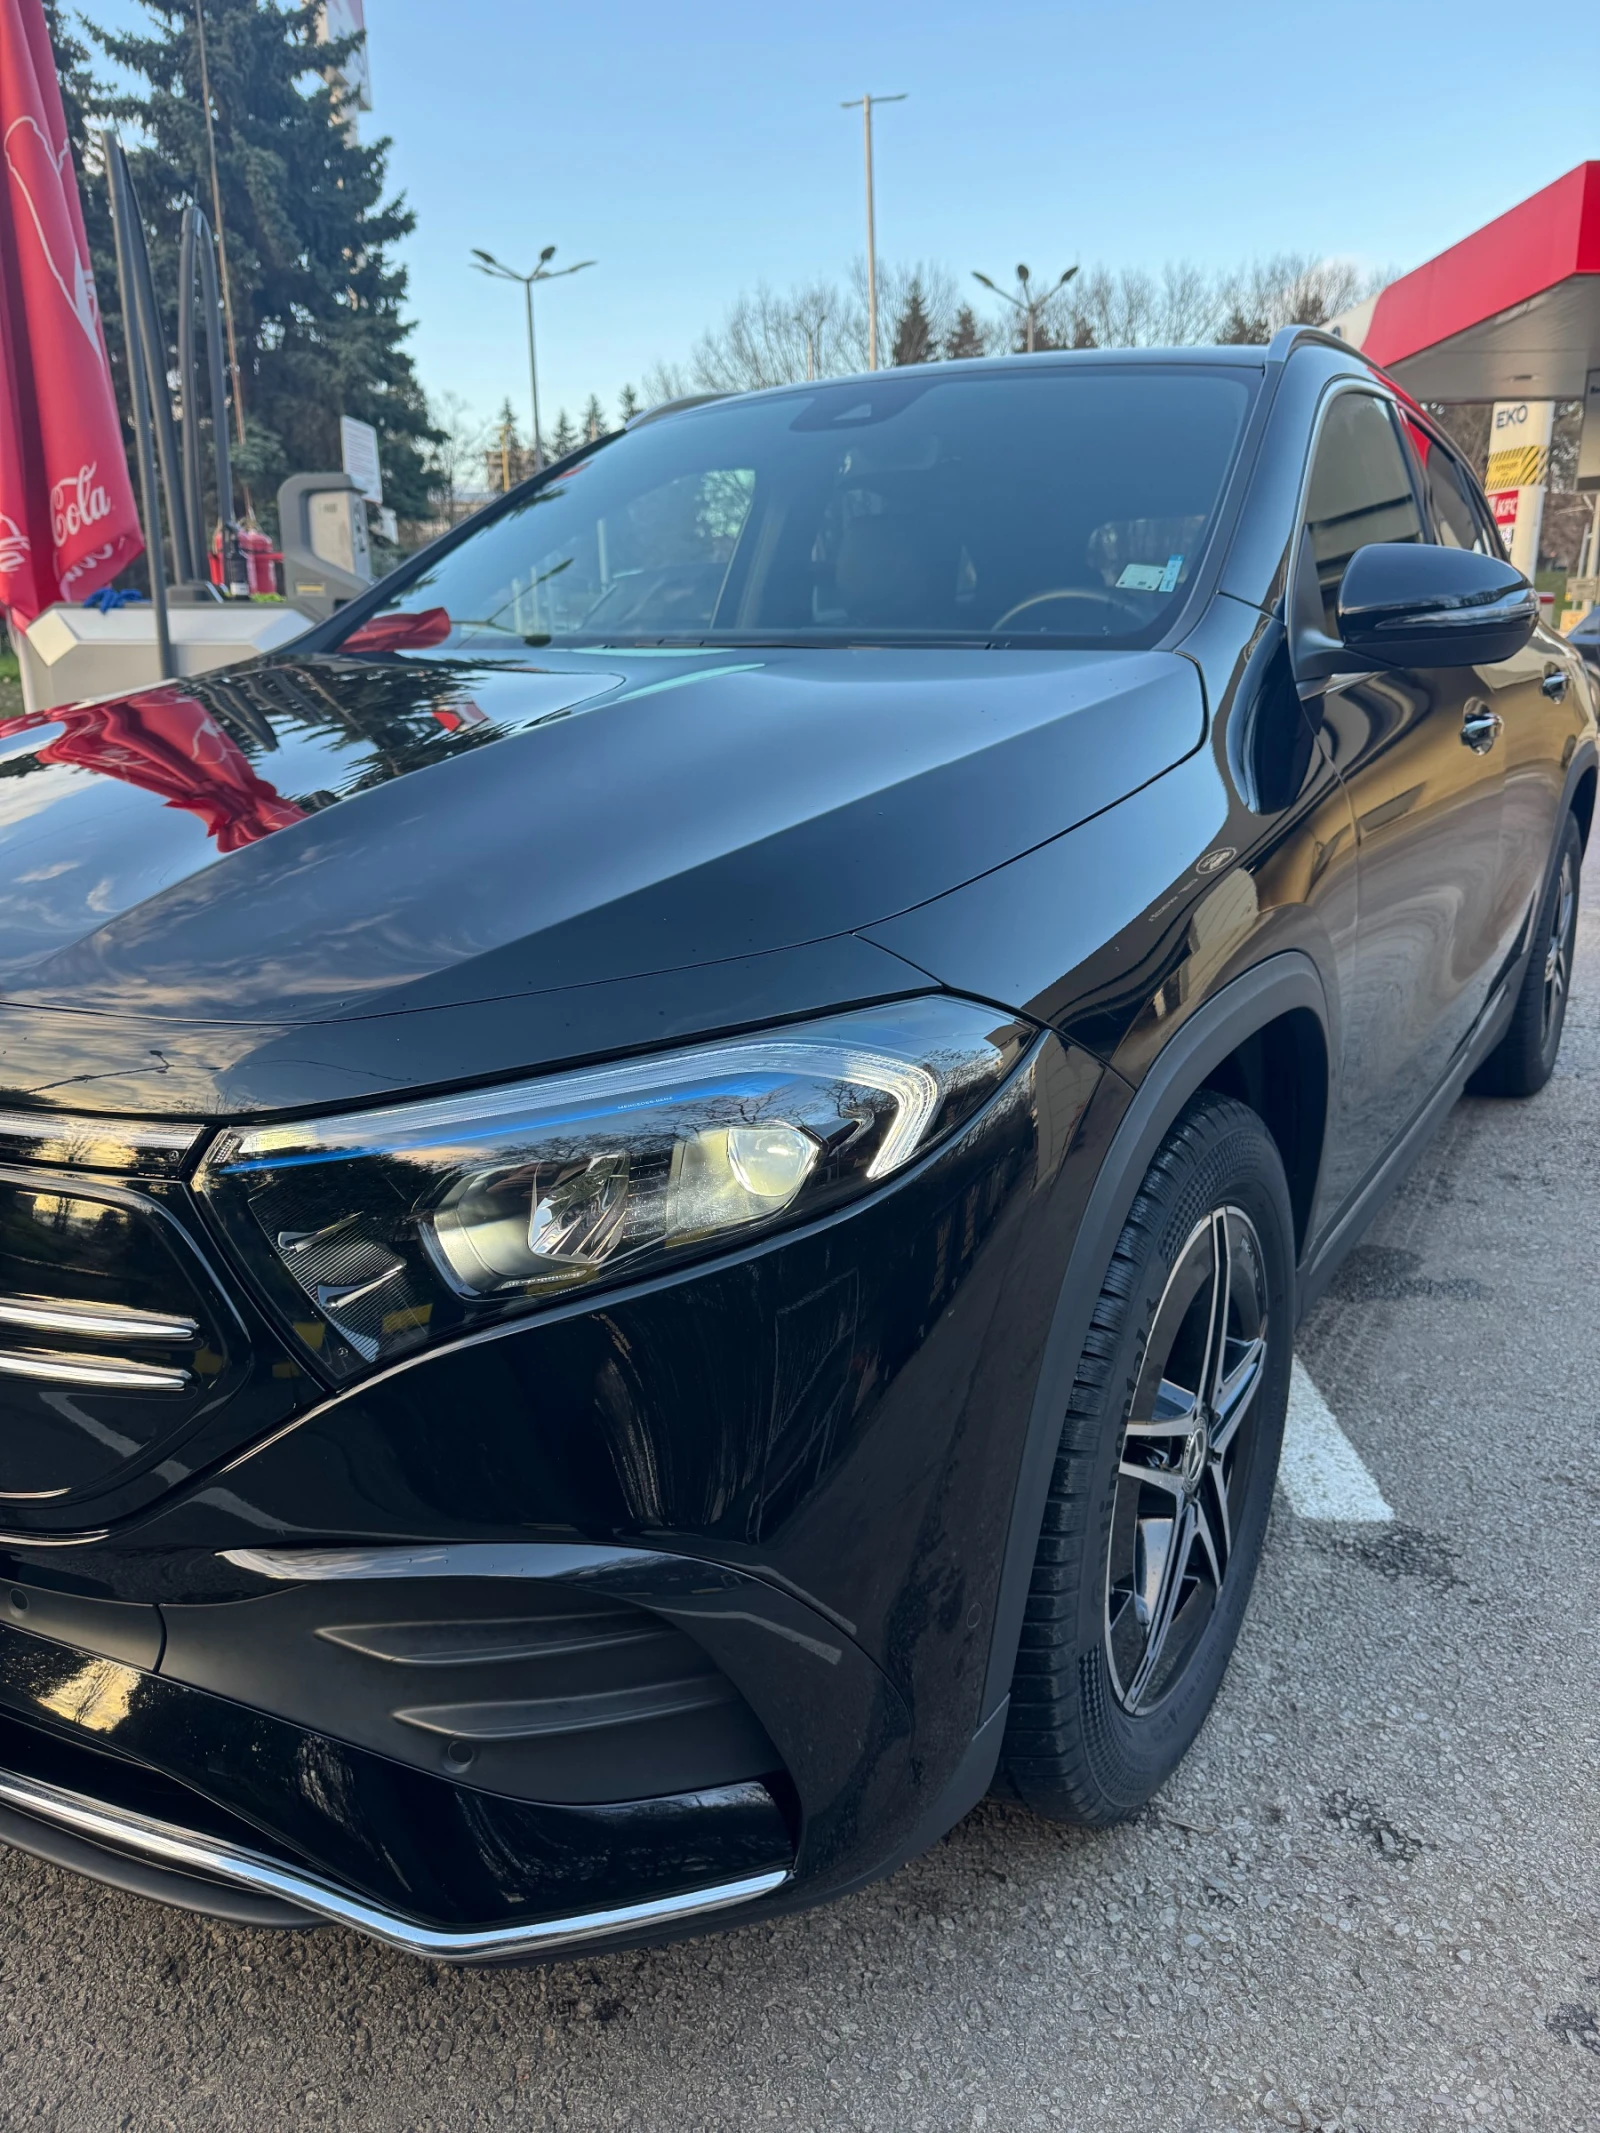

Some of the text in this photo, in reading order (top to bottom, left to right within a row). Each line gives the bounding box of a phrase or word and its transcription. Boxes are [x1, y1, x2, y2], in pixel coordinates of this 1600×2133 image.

[1497, 404, 1528, 429] EKO
[51, 461, 111, 547] Cola
[1497, 498, 1517, 517] KFC
